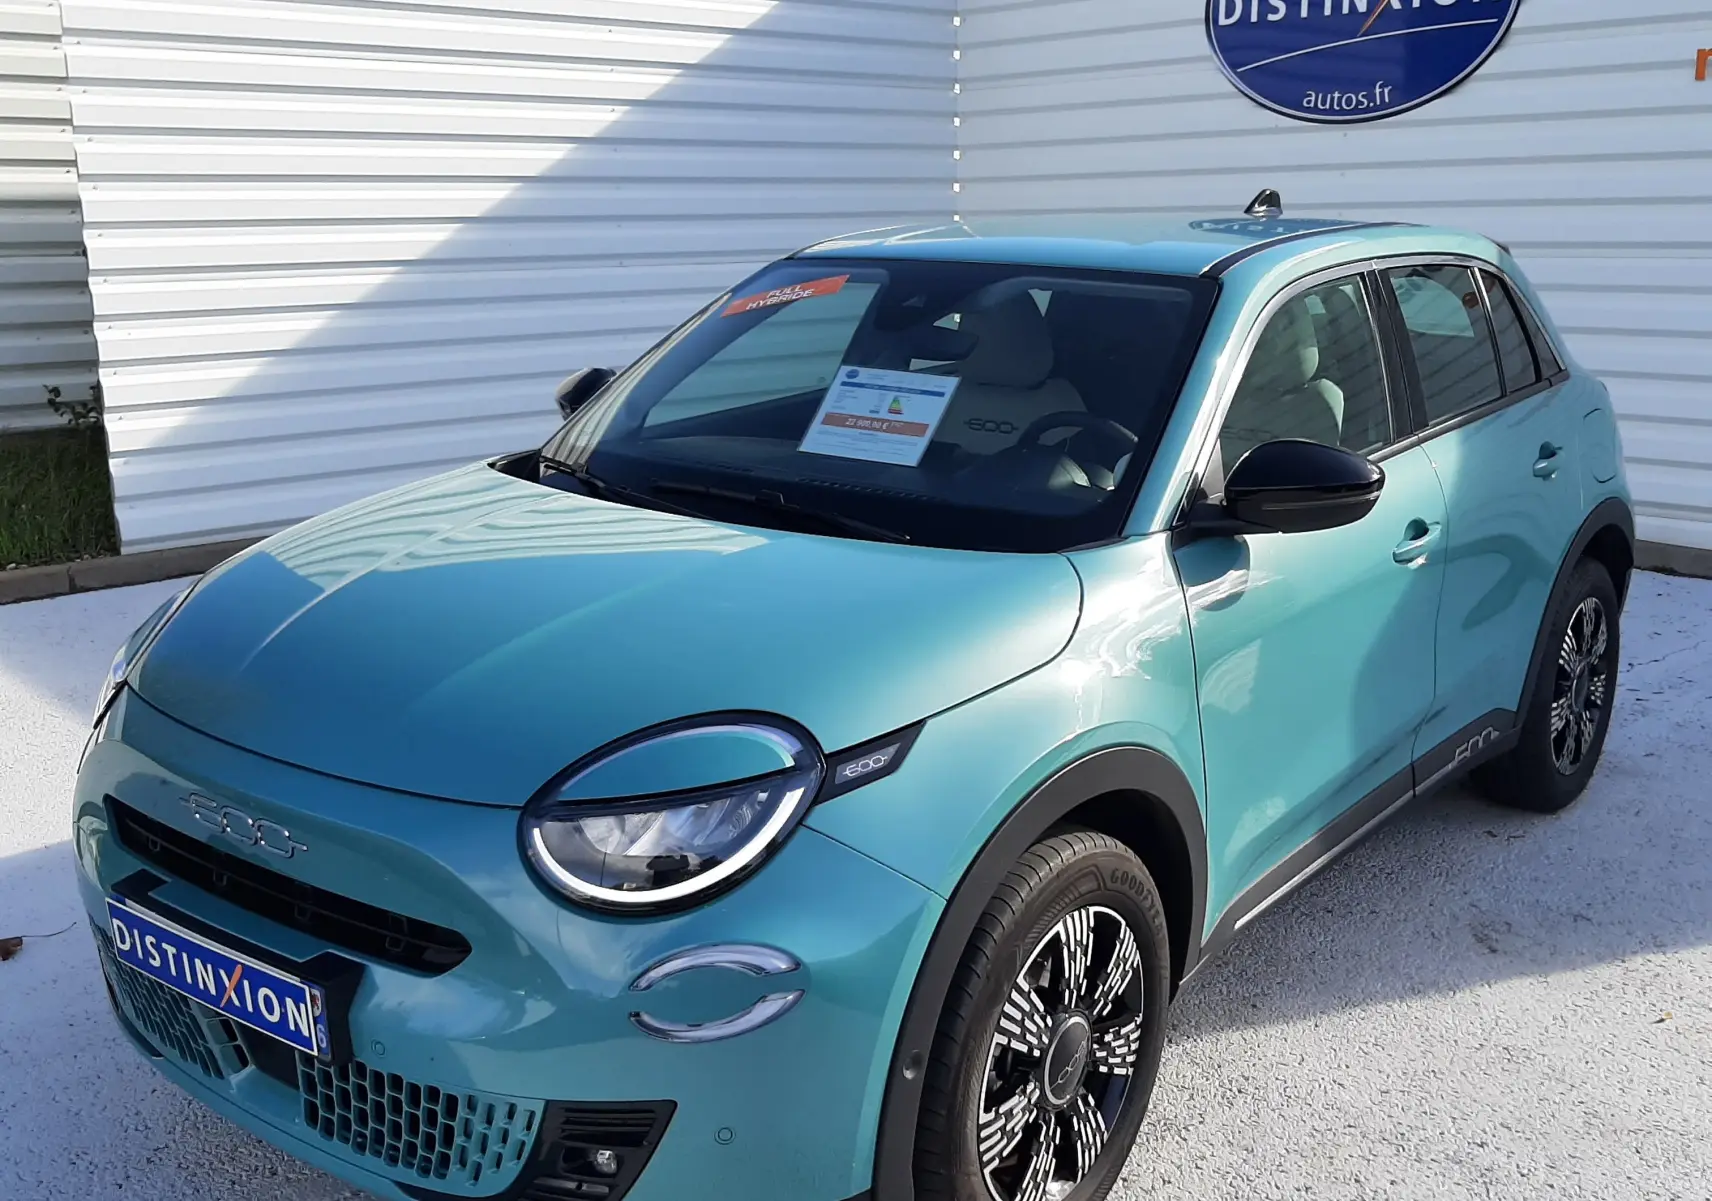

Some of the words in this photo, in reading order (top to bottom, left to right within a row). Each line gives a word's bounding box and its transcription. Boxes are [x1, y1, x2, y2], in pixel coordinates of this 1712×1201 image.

[1302, 80, 1393, 110] autos.fr
[745, 288, 815, 310] HYBRIDE
[766, 285, 803, 299] FULL
[842, 755, 888, 777] 600
[180, 792, 308, 858] 600
[111, 917, 310, 1038] DISTINXION
